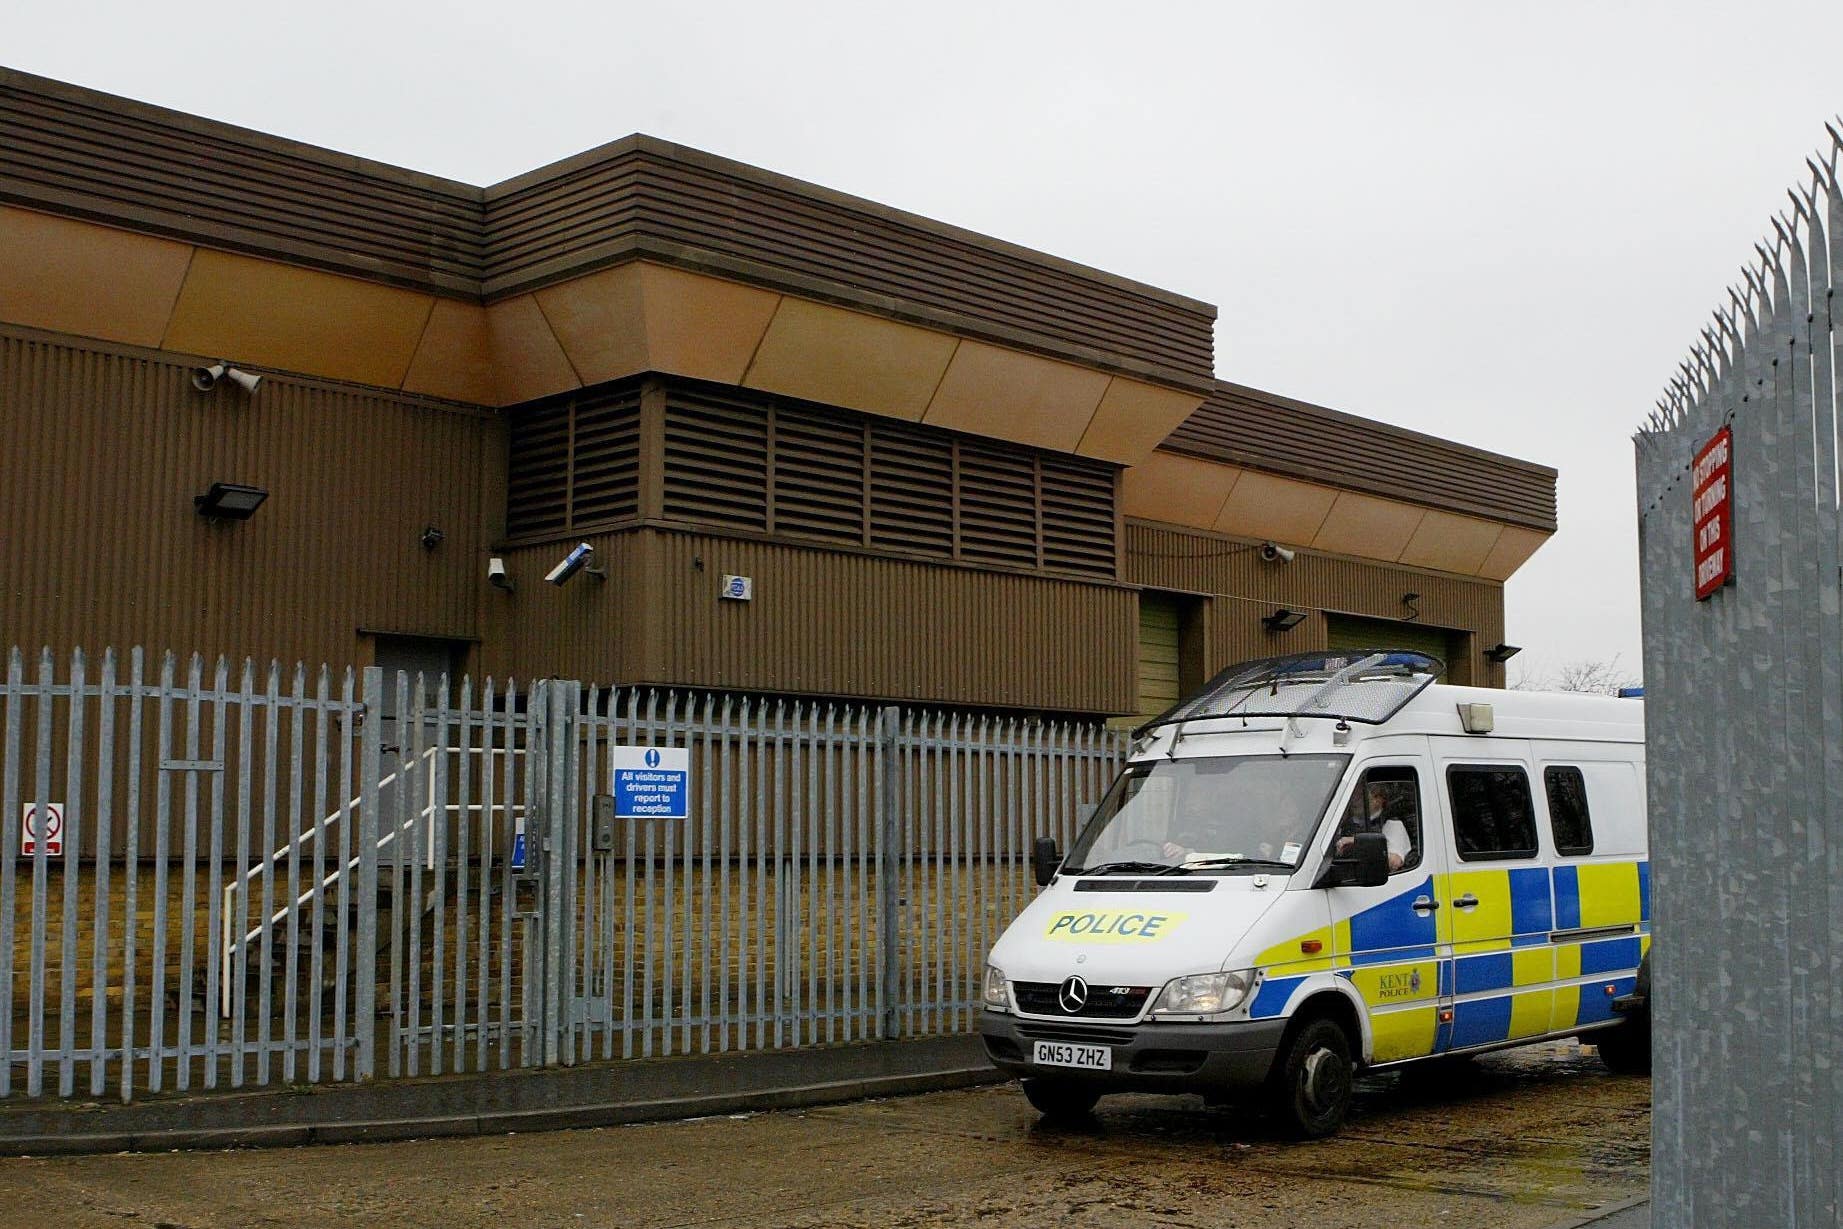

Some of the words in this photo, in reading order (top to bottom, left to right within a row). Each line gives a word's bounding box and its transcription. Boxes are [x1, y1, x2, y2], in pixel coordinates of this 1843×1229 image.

[621, 771, 633, 781] All
[635, 772, 665, 781] visitors
[666, 773, 681, 781] and
[626, 782, 656, 792] drivers
[657, 783, 677, 792] must
[634, 794, 661, 804] report
[662, 794, 670, 802] to
[633, 804, 672, 815] reception
[1049, 913, 1168, 937] POLICE
[1379, 973, 1409, 989] KENT
[1379, 987, 1409, 998] POLICE
[1039, 1045, 1073, 1063] GN53
[1077, 1048, 1104, 1066] ZHZ
